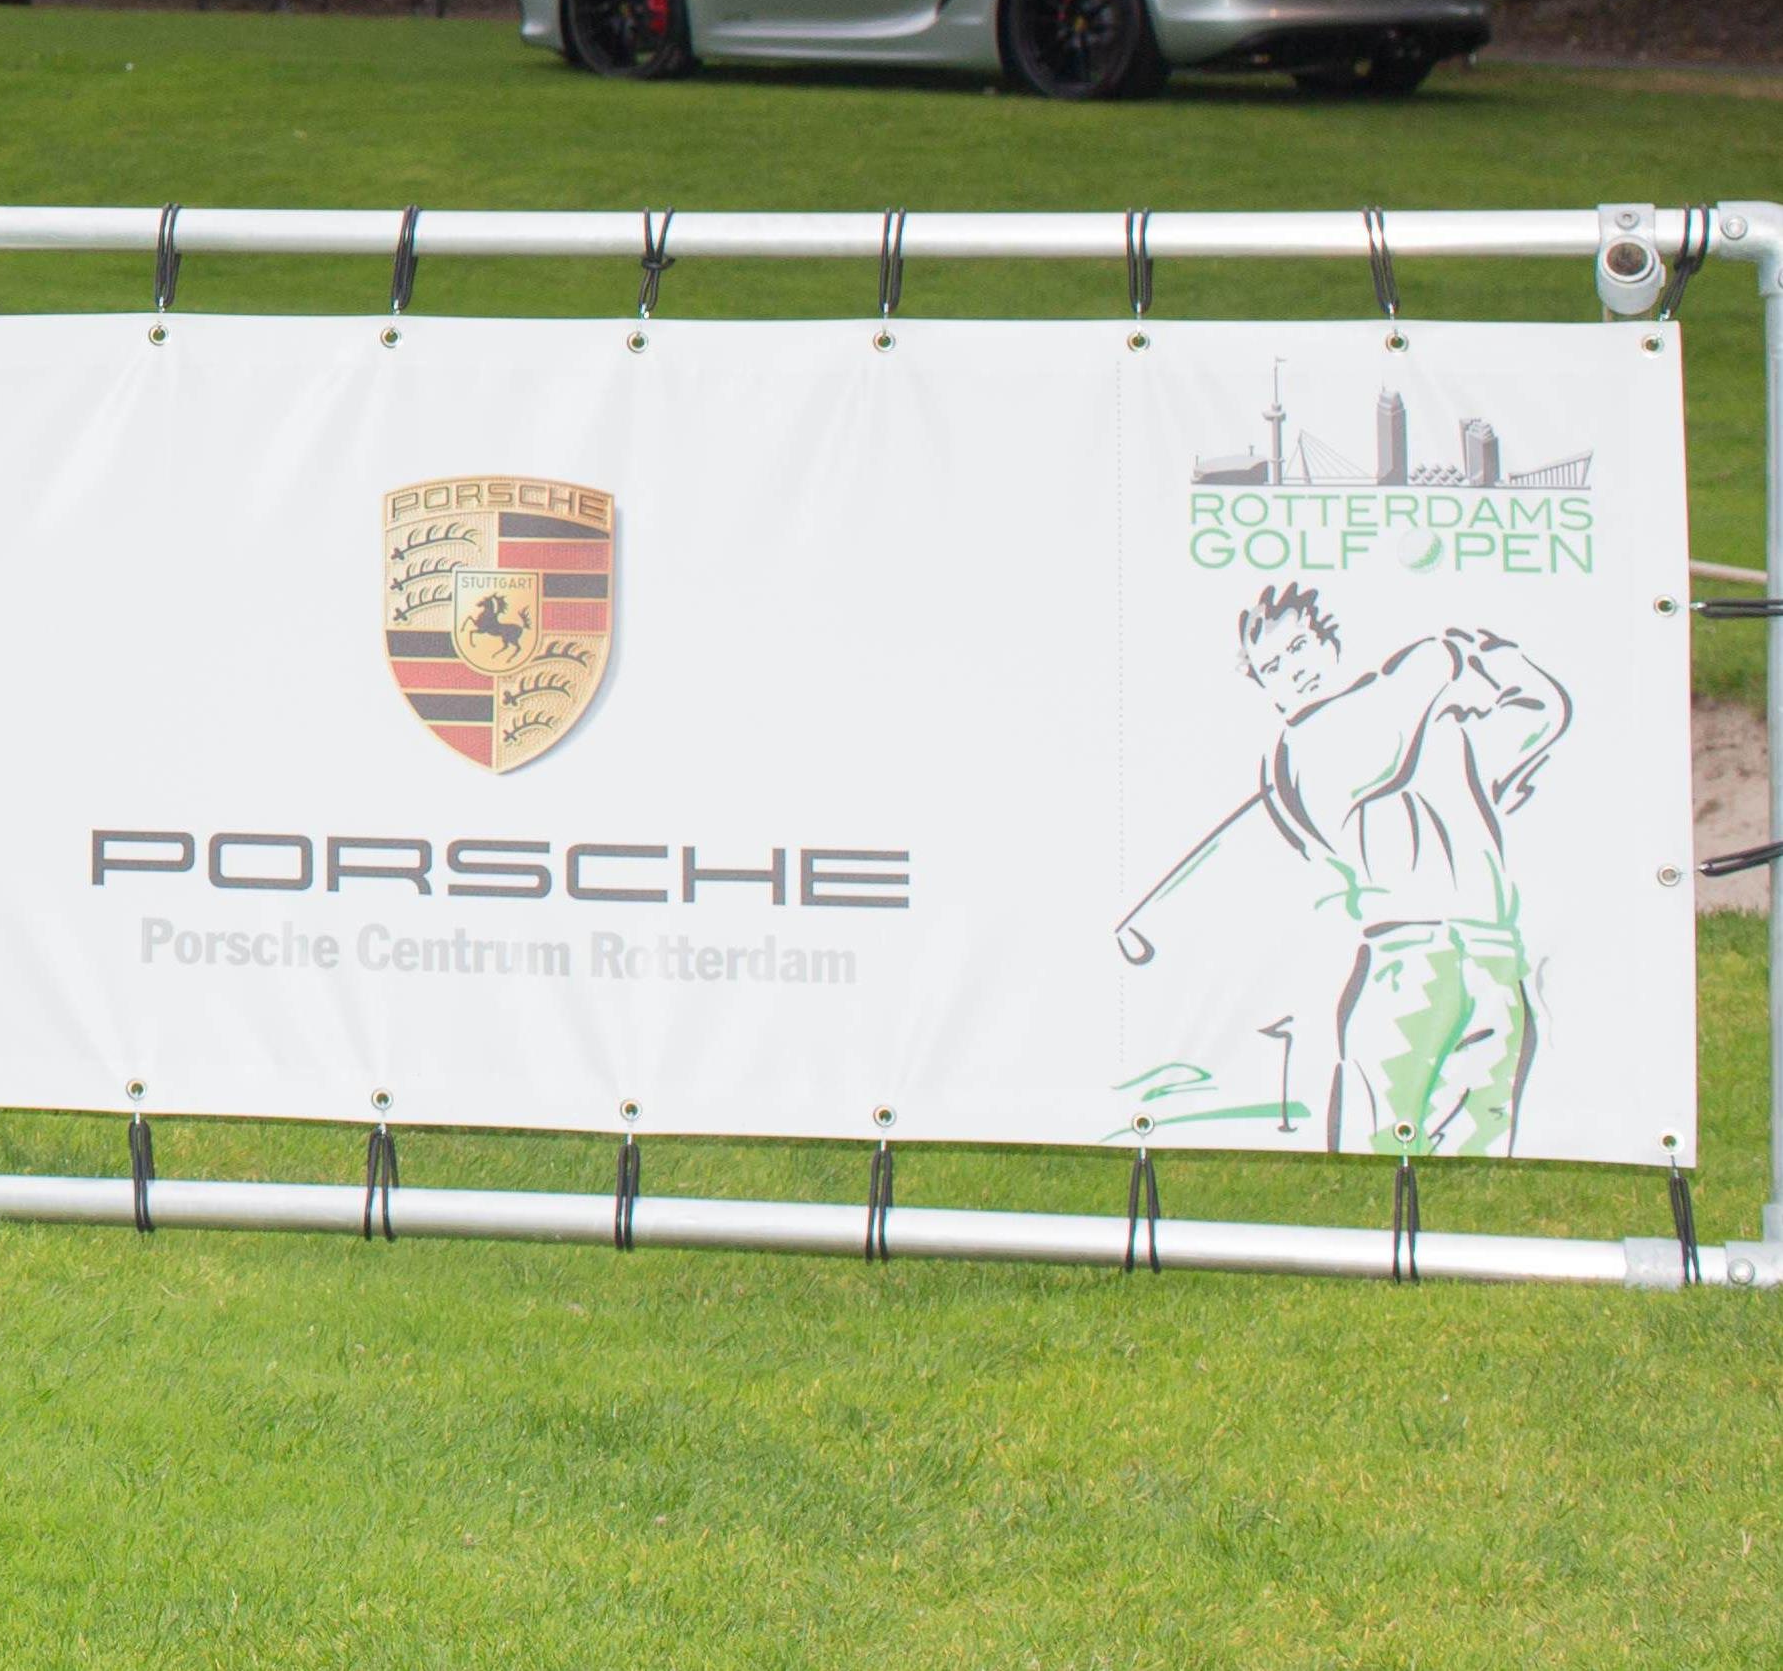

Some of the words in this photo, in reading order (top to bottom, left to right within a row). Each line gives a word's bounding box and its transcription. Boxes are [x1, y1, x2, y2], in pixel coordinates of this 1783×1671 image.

[391, 482, 609, 521] PORSCHE
[1190, 492, 1594, 531] ROTTERDAMS
[1189, 527, 1378, 571] GOLF
[461, 576, 534, 589] STUTTGART
[92, 829, 910, 909] PORSCHE
[141, 917, 339, 970] Porsche
[357, 922, 571, 978] Centrum
[590, 930, 857, 985] Rotterdam
